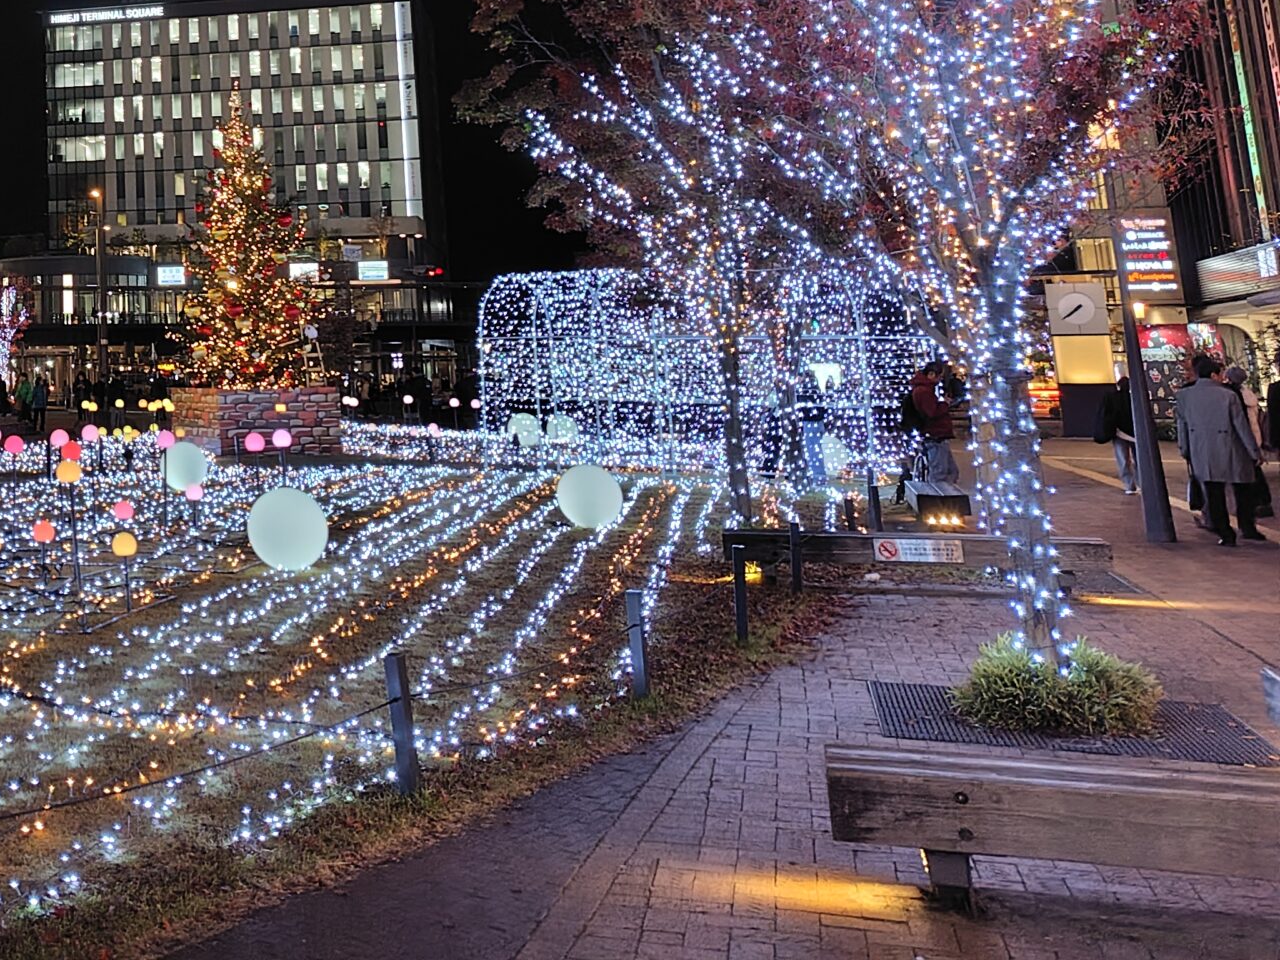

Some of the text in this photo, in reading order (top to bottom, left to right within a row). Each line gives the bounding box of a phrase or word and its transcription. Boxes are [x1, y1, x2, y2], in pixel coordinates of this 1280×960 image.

[50, 6, 164, 24] HIMEJI TERMINAL SQUARE
